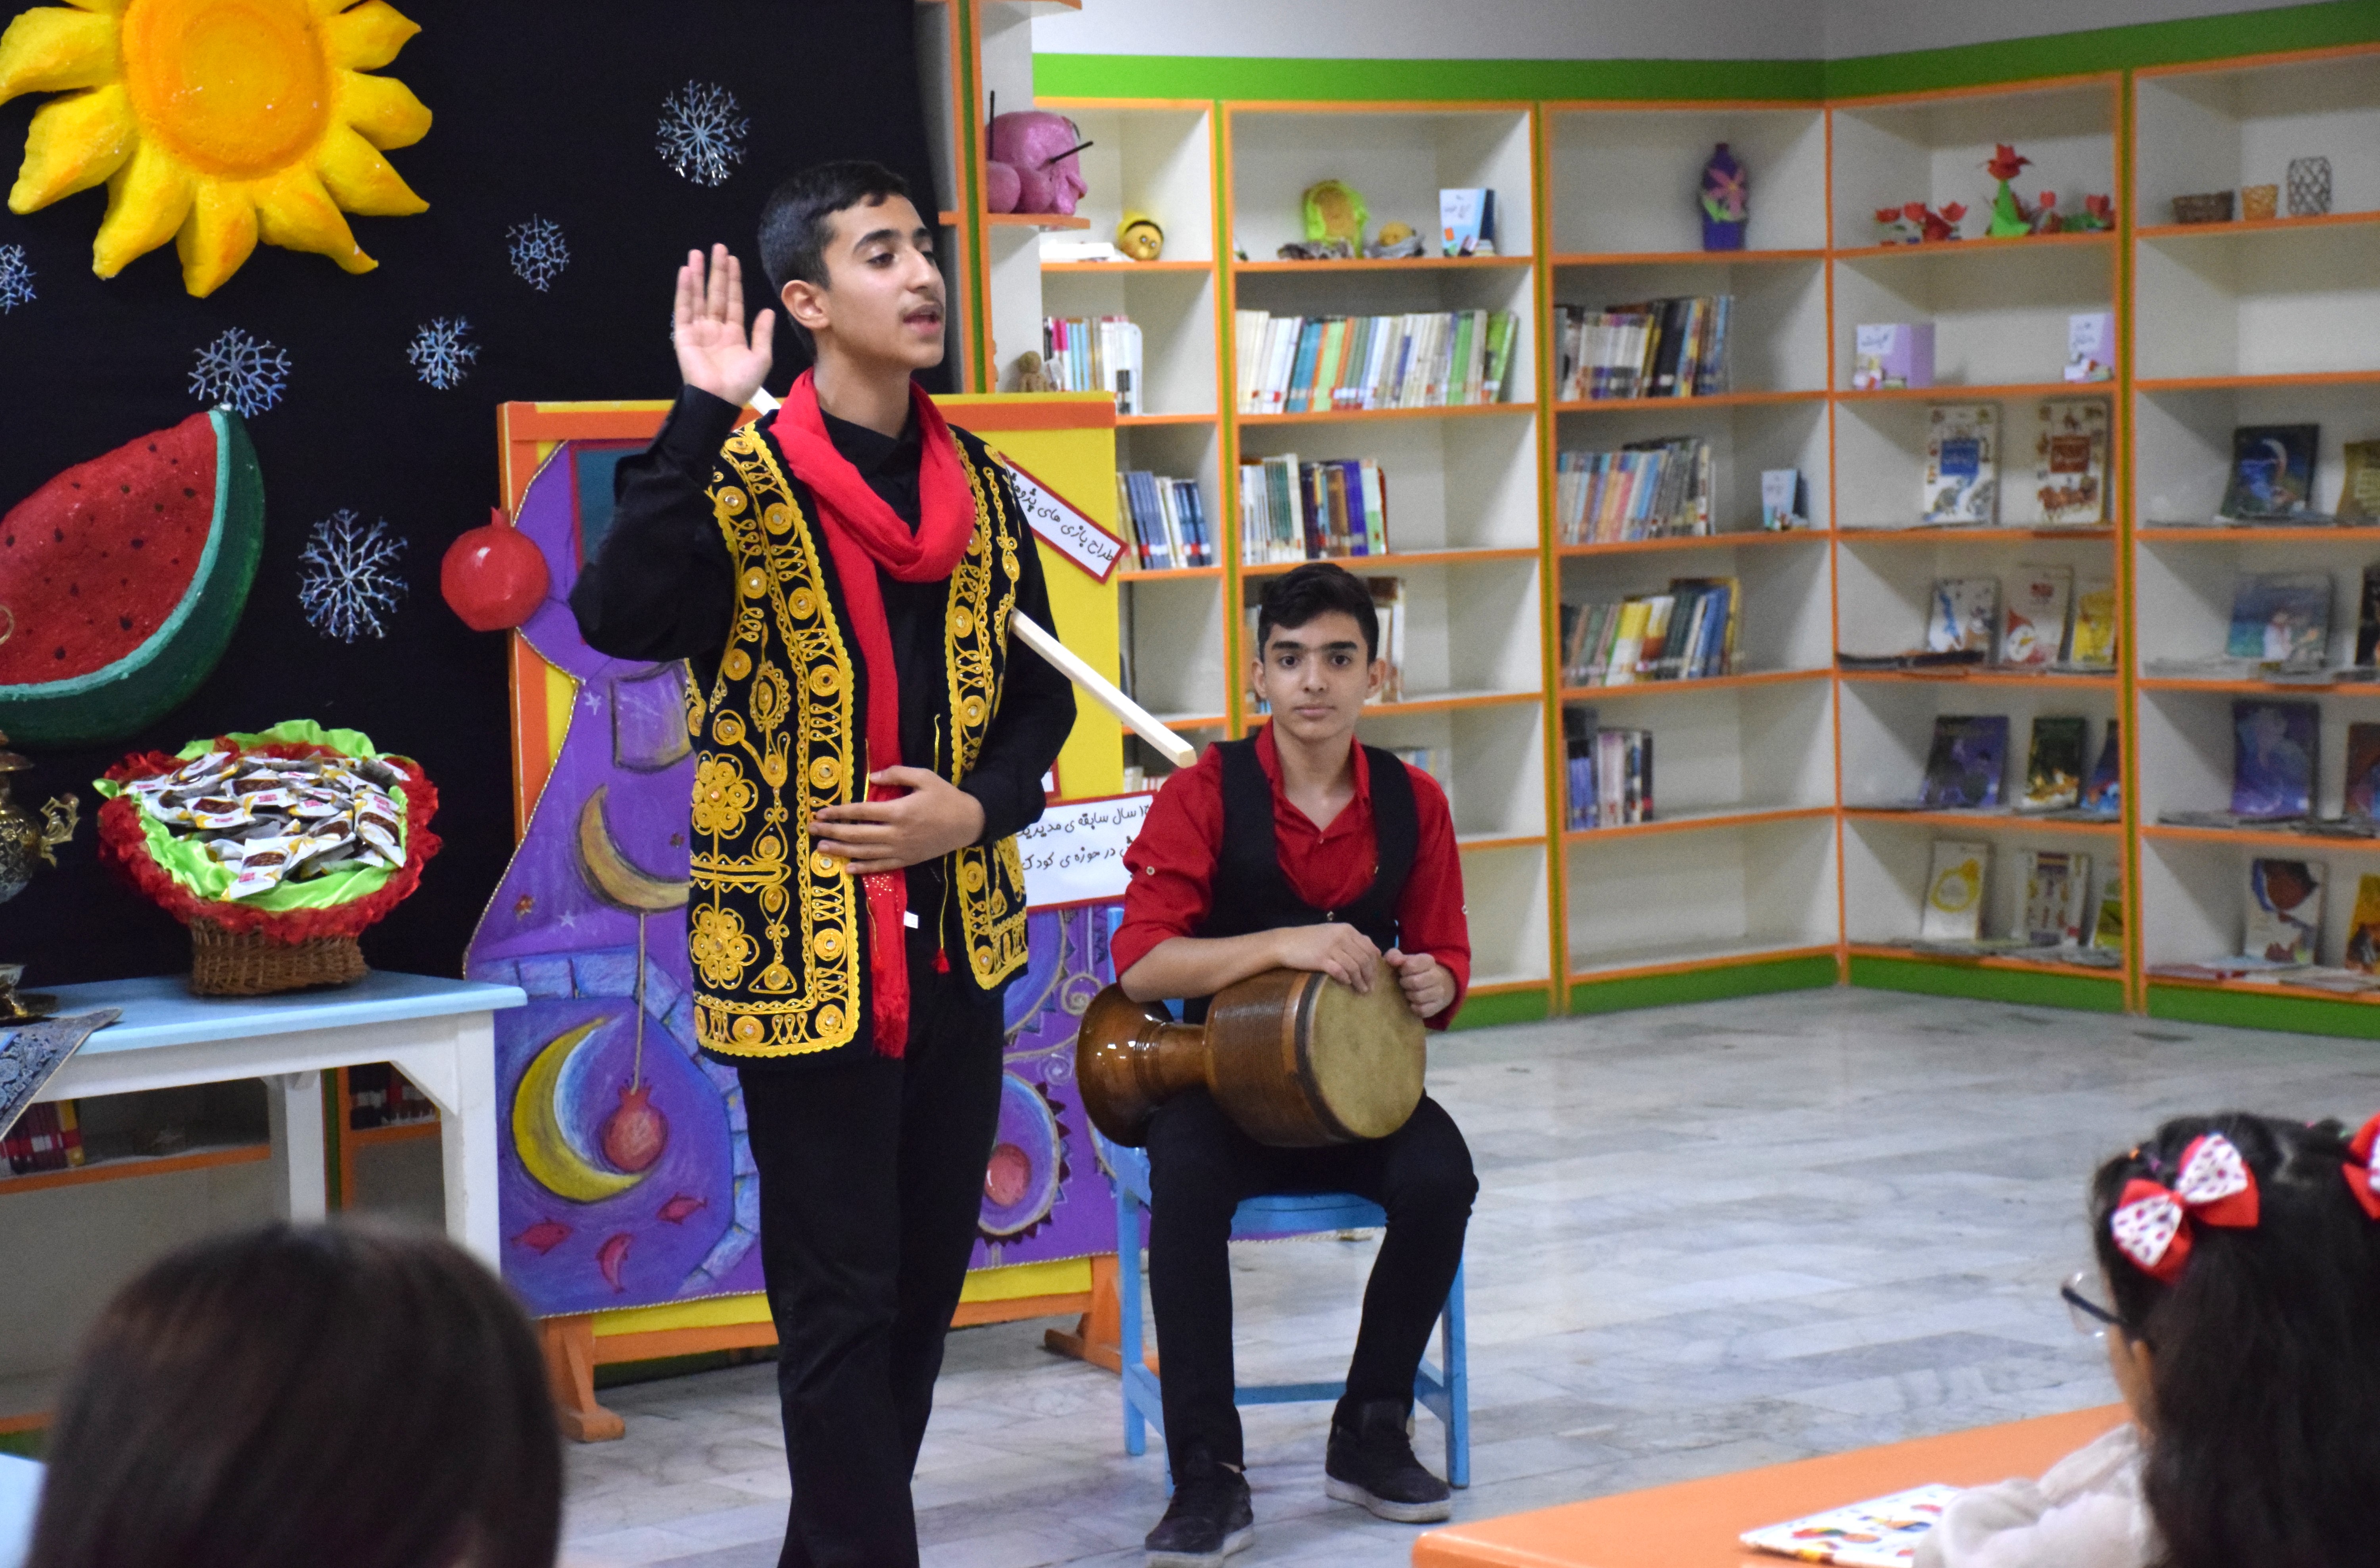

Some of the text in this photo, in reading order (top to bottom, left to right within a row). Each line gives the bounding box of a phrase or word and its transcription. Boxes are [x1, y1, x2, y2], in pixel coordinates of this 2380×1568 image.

[1012, 472, 1113, 562] طراح بازی های پژوه
[1078, 813, 1108, 830] سابقه
[1113, 807, 1136, 825] سال
[1022, 851, 1054, 870] کودک
[1075, 846, 1100, 864] حوزه
[1104, 847, 1116, 859] در
